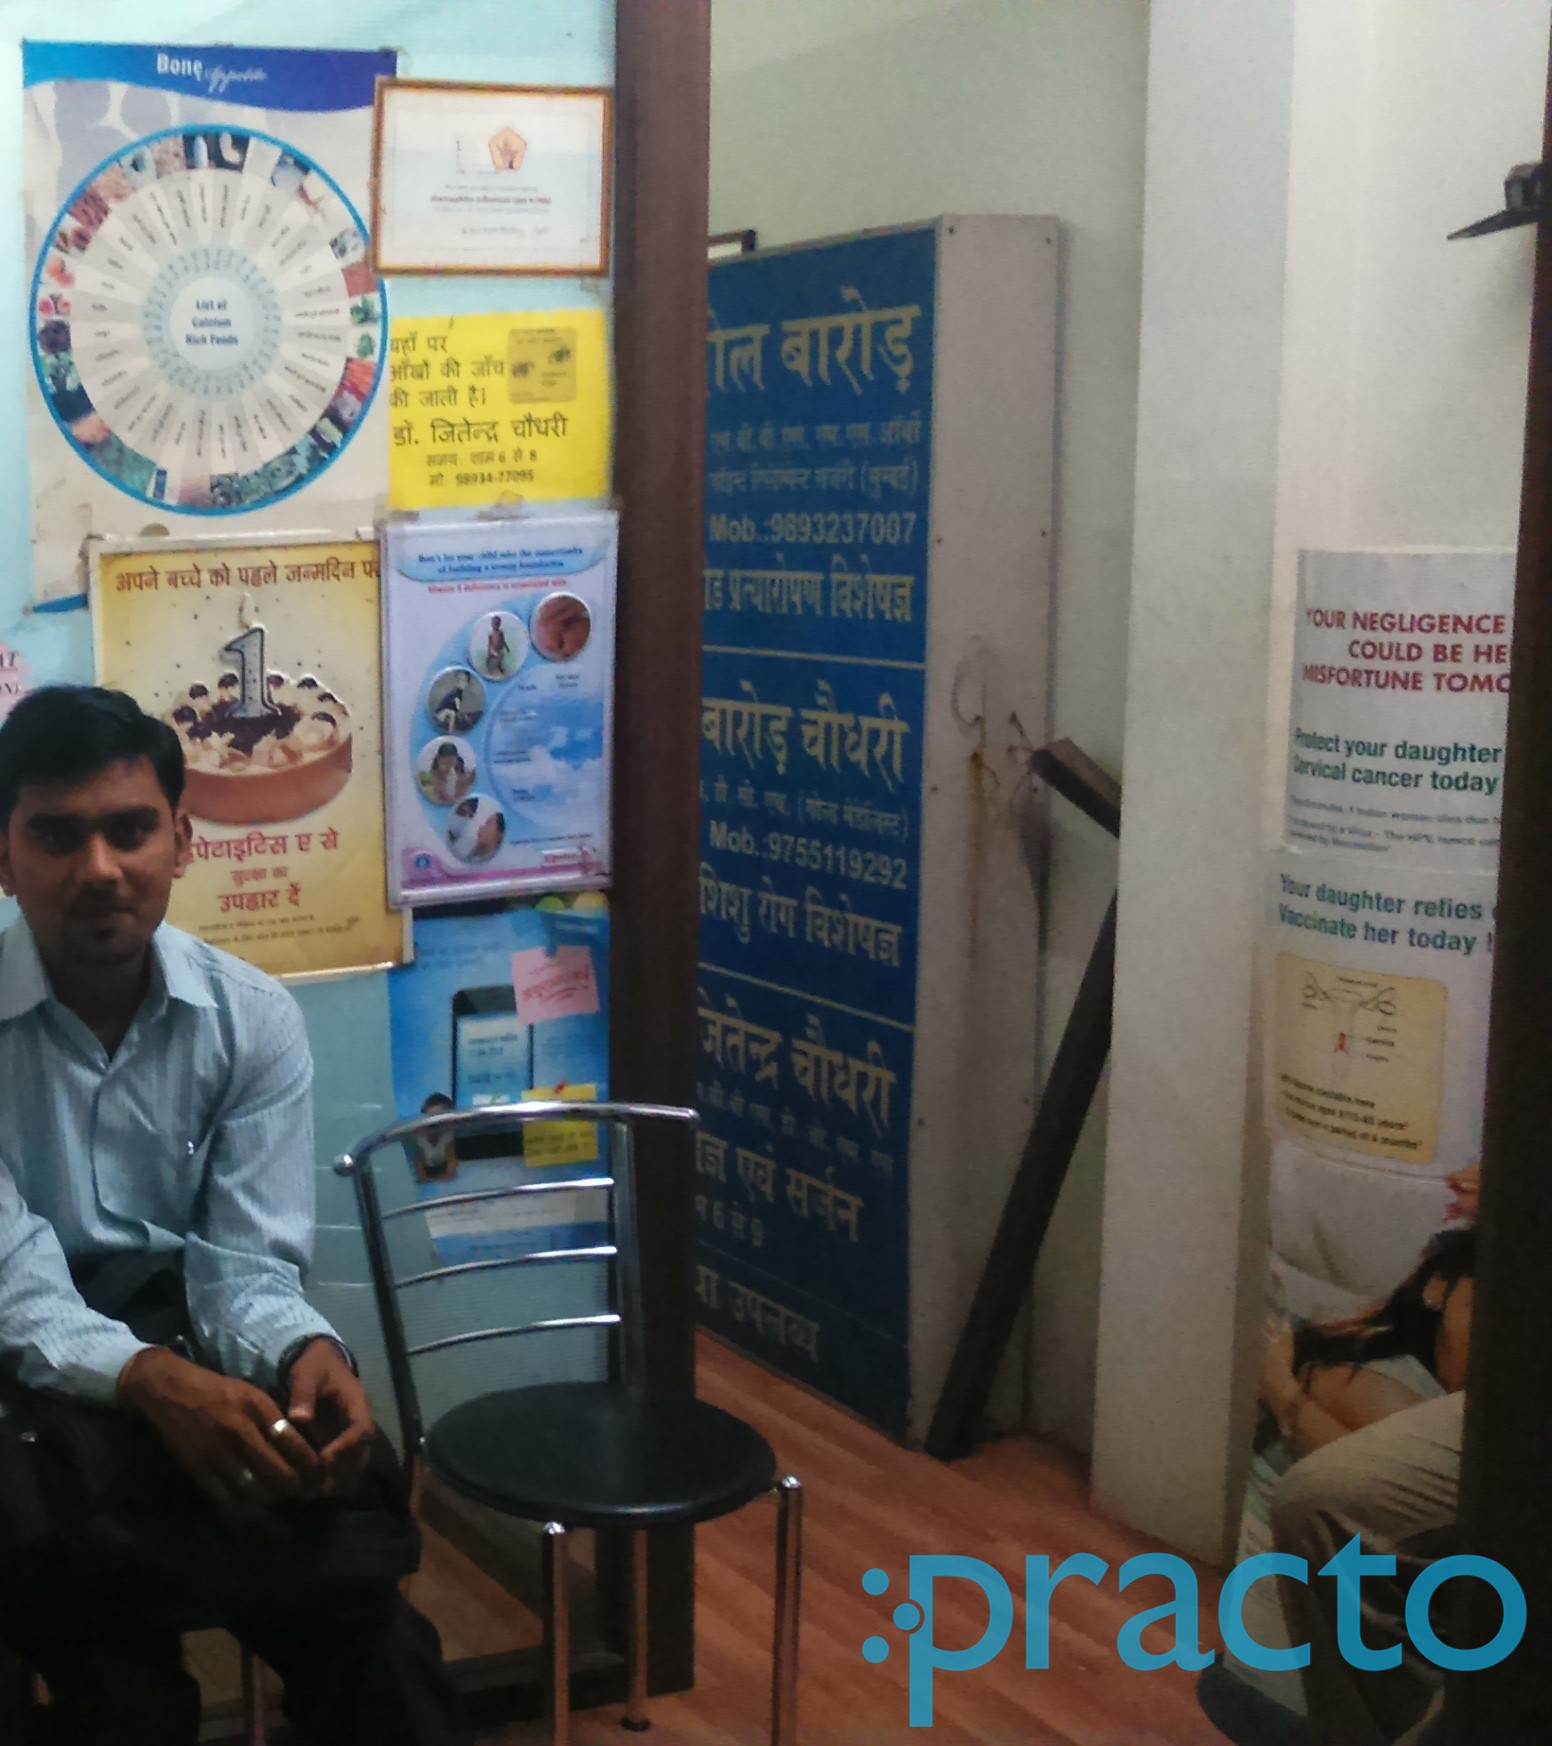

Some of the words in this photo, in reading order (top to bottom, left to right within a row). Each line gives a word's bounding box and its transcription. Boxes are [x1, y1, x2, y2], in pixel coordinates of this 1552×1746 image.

[156, 53, 203, 80] Bone
[425, 335, 449, 354] पर
[439, 356, 462, 379] की
[418, 383, 459, 409] जाती
[509, 410, 570, 438] चौधरी
[115, 565, 160, 594] अपने
[165, 562, 204, 590] बच्चे
[209, 561, 231, 588] को
[236, 560, 279, 588] पहले
[285, 556, 356, 585] जन्मदिन
[1351, 609, 1507, 635] NEGLIGENCE
[1347, 639, 1423, 663] COULD
[1432, 643, 1463, 664] BE
[1301, 663, 1424, 692] MISFORTUNE
[800, 678, 911, 794] चौधरी
[1344, 738, 1388, 760] your
[1394, 741, 1504, 767] daughter
[1351, 766, 1423, 789] cancer
[1431, 770, 1499, 797] today
[190, 831, 289, 864] पेटाइटिस
[294, 832, 314, 853] ए
[318, 826, 340, 851] से
[217, 889, 280, 914] उपहार
[757, 875, 799, 938] रोग
[1280, 872, 1312, 899] Your
[1315, 882, 1405, 915] daughter
[1412, 897, 1483, 921] relies
[1278, 903, 1358, 941] Vaccinate
[1364, 921, 1399, 945] her
[1407, 927, 1477, 956] today
[790, 1013, 897, 1137] चौधरी
